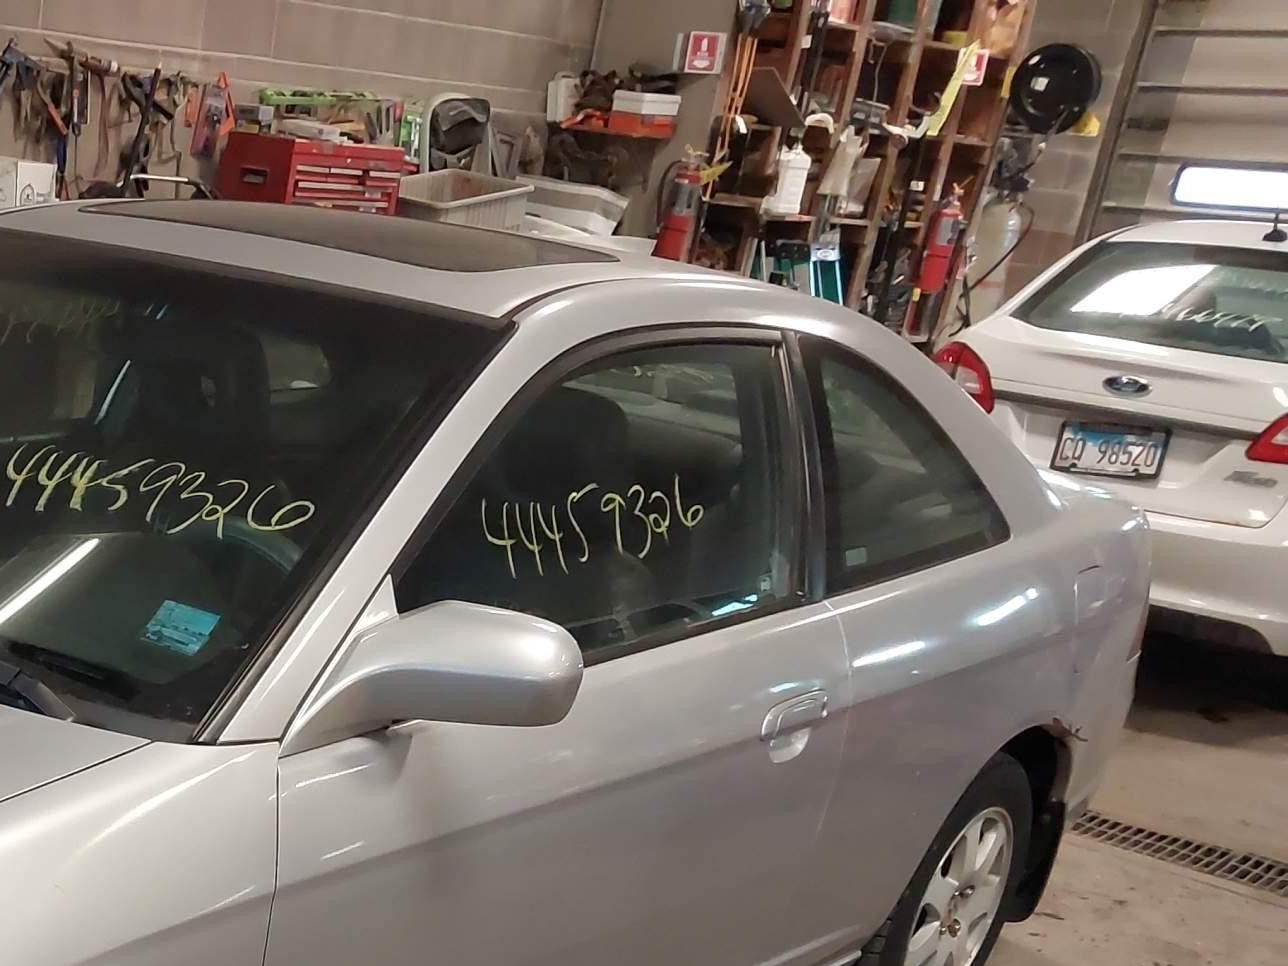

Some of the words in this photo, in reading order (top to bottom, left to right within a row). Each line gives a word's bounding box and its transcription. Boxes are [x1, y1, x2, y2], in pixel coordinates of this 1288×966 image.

[6, 443, 316, 540] 44459326
[1096, 439, 1159, 468] 98520
[481, 472, 705, 580] 44459326
